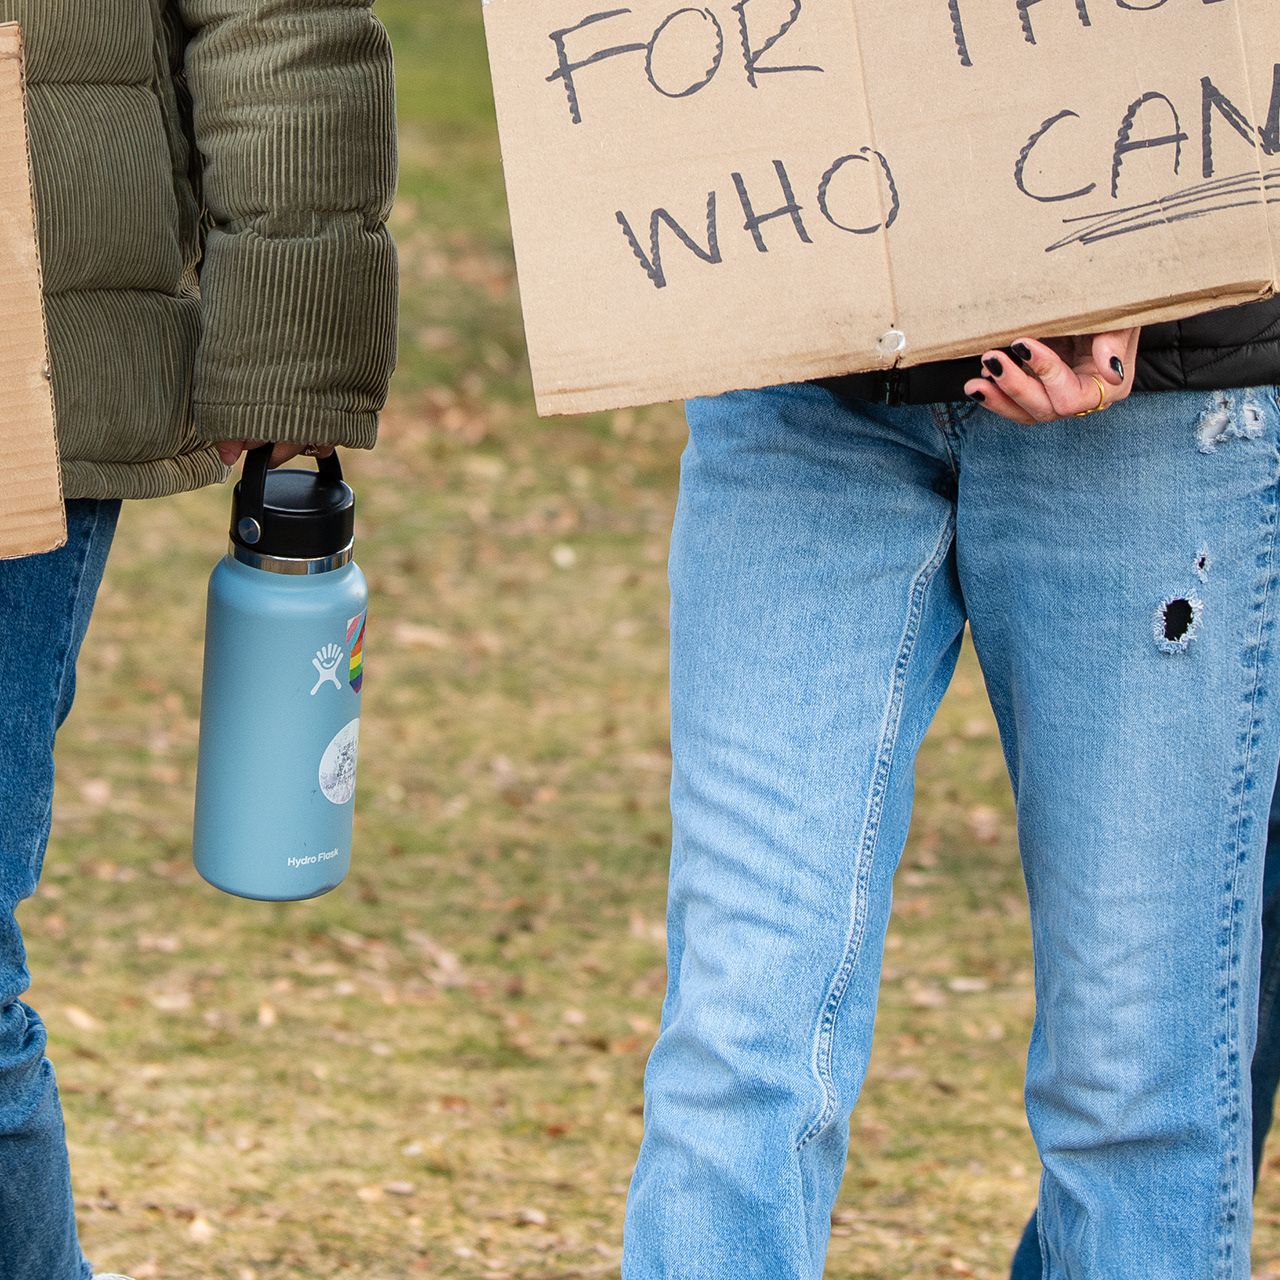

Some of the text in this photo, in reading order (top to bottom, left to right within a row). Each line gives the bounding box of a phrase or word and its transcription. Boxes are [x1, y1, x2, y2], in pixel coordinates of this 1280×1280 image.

[615, 146, 900, 289] WHO
[287, 847, 339, 868] Hydro Flask
